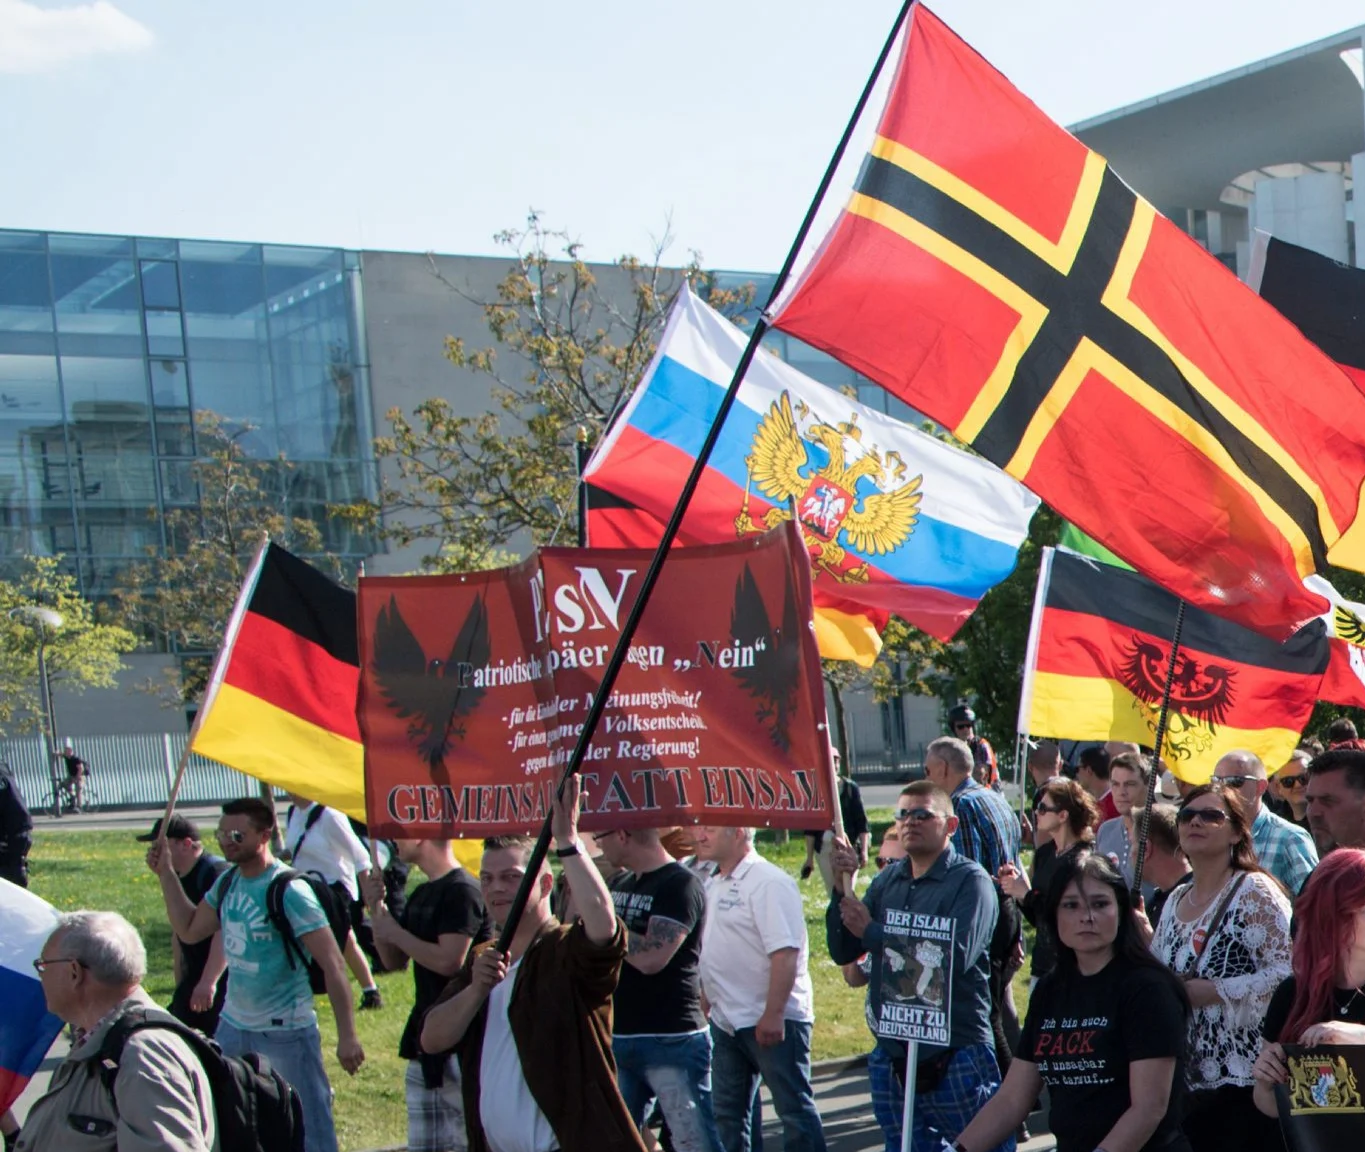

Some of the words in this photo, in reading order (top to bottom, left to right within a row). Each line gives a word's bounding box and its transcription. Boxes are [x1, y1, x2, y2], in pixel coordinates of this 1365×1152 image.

[616, 736, 701, 761] Regierung!
[886, 910, 912, 928] DER
[912, 912, 952, 932] ISLAM
[881, 1004, 925, 1023] NICHT
[927, 1009, 946, 1027] ZU
[879, 1020, 948, 1042] DEUTSCHLAND
[1034, 1030, 1097, 1056] PACK
